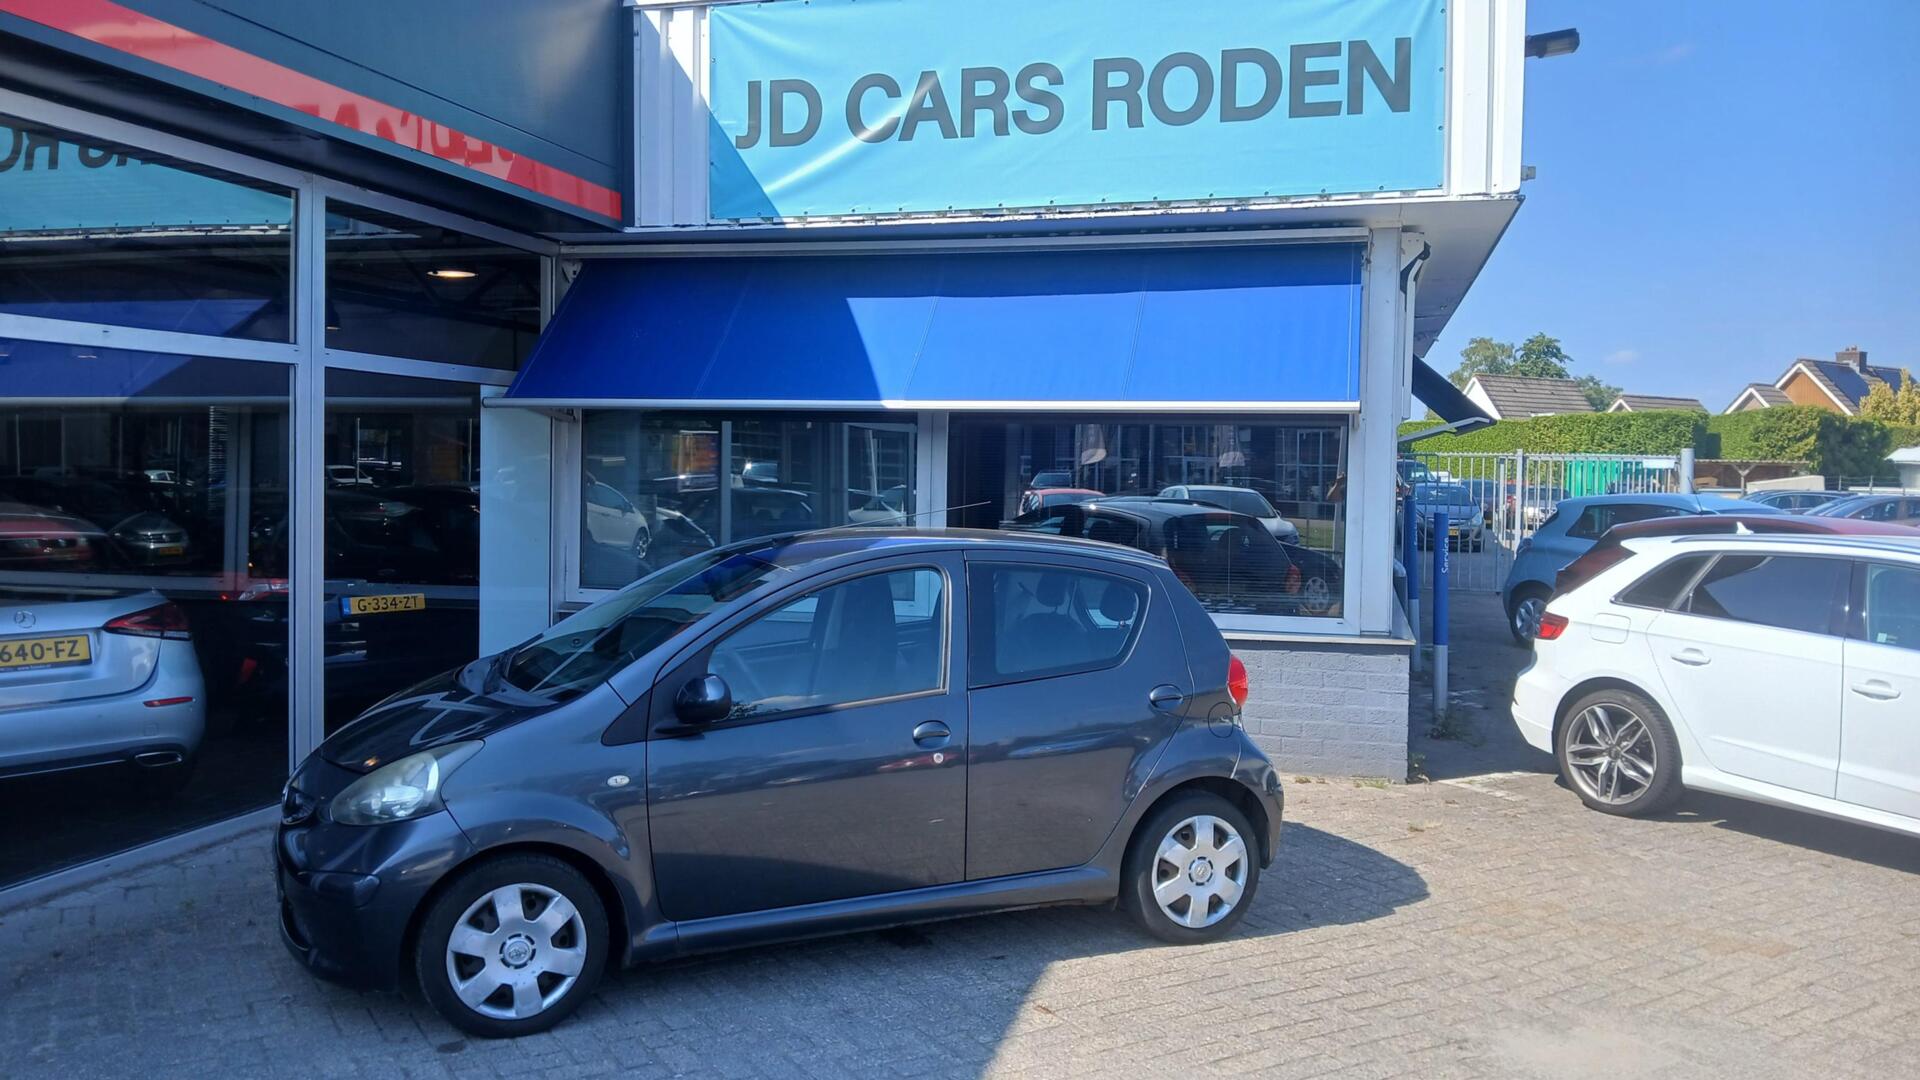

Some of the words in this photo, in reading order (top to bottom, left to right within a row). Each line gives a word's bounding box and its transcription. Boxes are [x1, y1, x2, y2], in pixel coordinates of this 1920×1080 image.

[735, 78, 823, 150] JD
[845, 62, 1064, 144] CARS
[1091, 37, 1412, 131] RODEN
